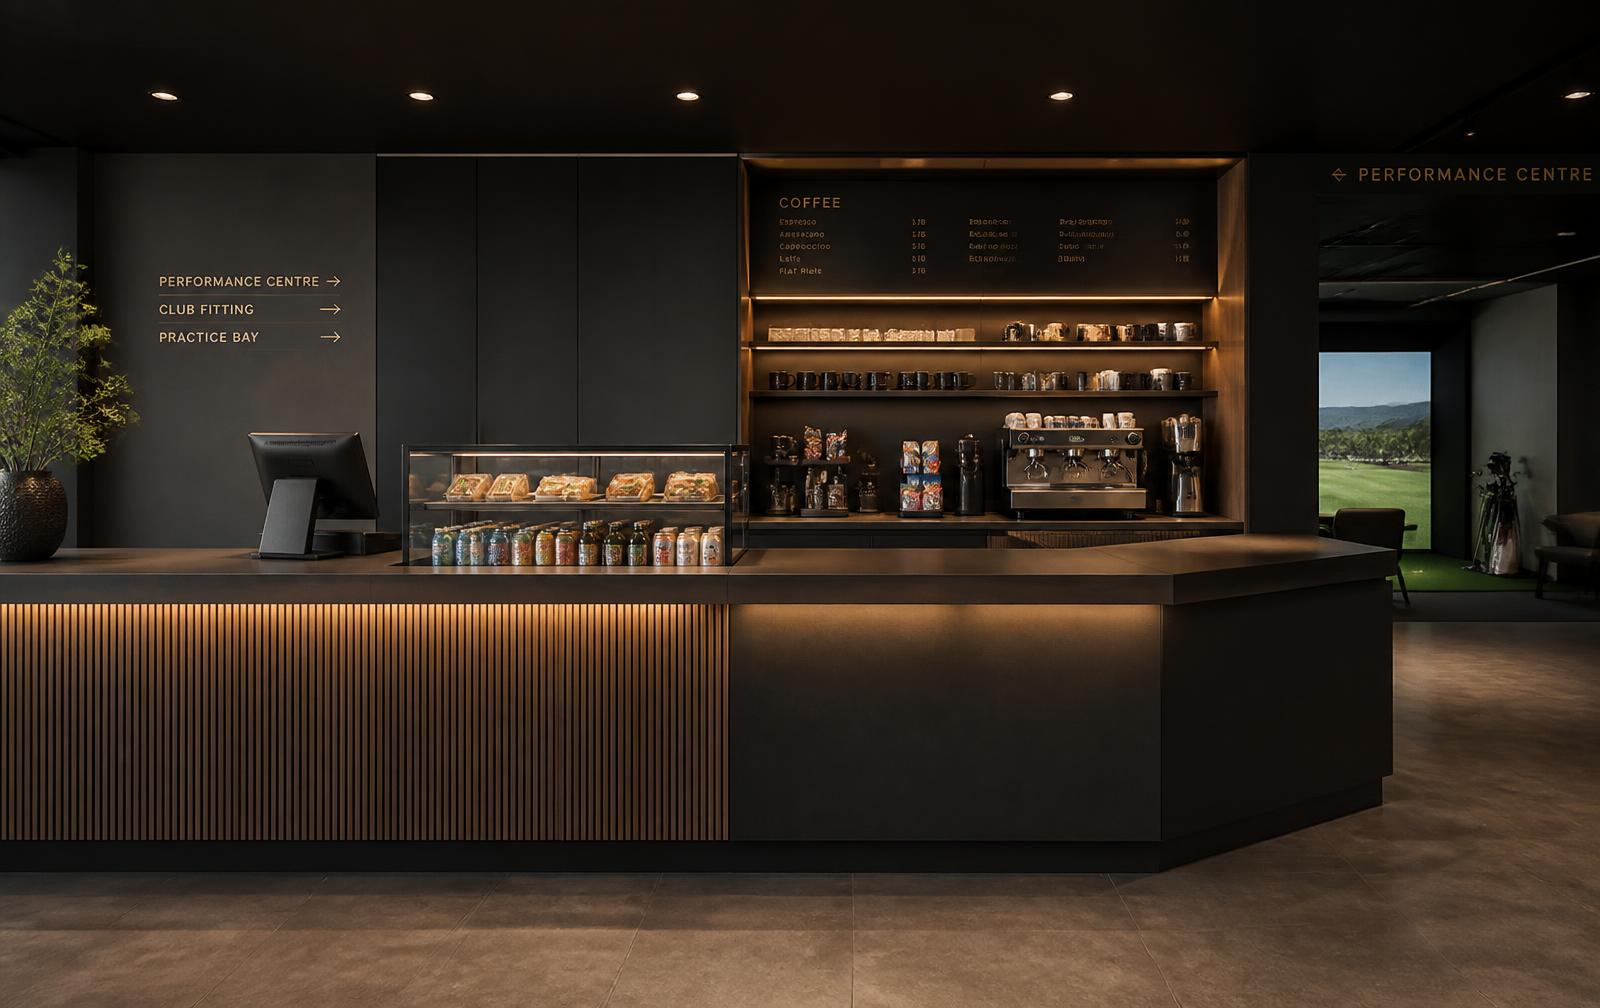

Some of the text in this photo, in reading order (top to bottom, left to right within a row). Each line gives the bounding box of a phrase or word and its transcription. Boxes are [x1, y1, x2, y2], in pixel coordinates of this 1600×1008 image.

[1359, 167, 1592, 182] PERFORMANCE CENTRE
[779, 196, 841, 209] COFFEE
[159, 275, 320, 287] PERFORMANCE CENTRE
[159, 303, 254, 315] CLUB FITTING
[159, 331, 259, 343] PRACTICE BAY
